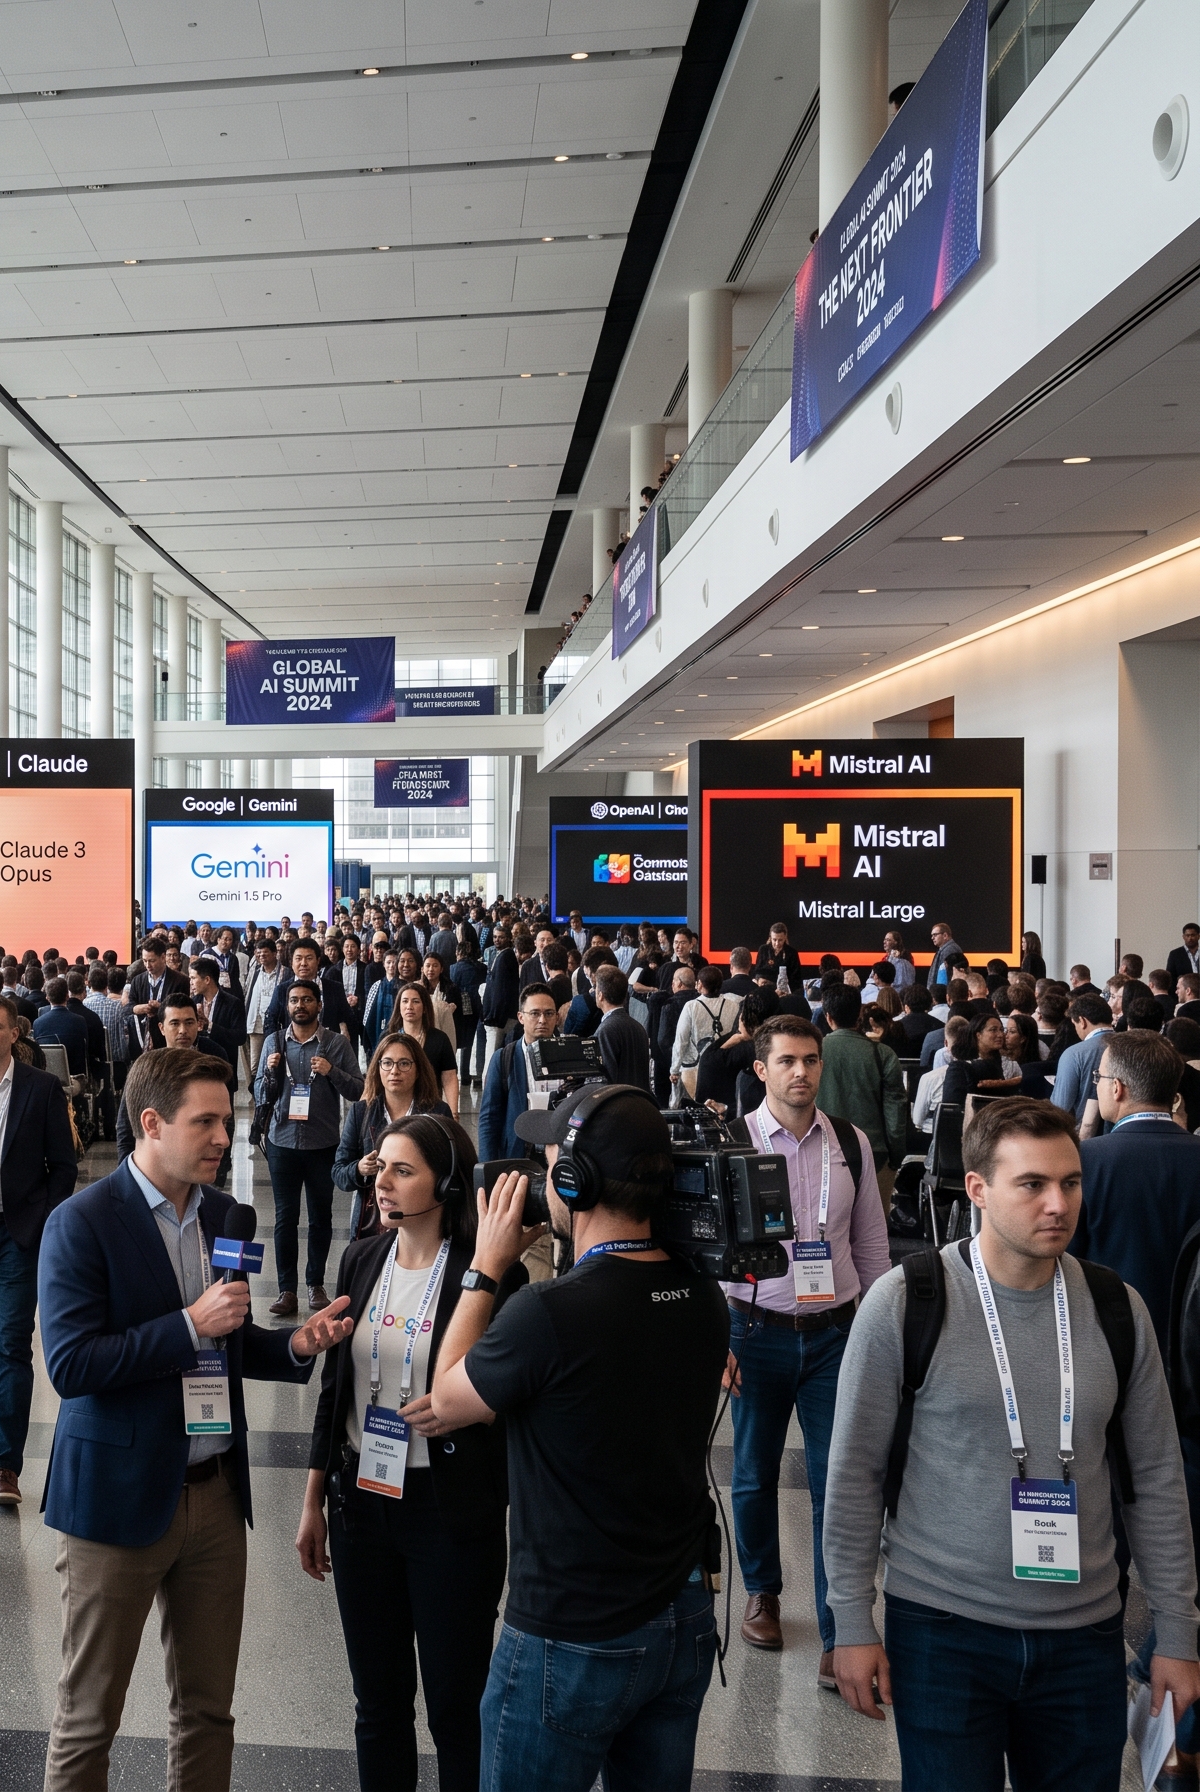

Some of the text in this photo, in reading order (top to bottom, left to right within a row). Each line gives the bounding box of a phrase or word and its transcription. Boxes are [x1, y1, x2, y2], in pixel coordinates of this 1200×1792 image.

[818, 274, 839, 330] THE
[840, 233, 869, 305] NEXT
[871, 147, 933, 264] FRONTIER
[856, 257, 886, 328] 2024
[272, 659, 347, 676] GLOBAL
[259, 676, 360, 694] AI SUMMIT
[286, 694, 333, 712] 2024
[18, 754, 88, 773] Claude
[829, 754, 903, 774] Mistral
[907, 754, 931, 774] AI
[407, 789, 433, 800] 2024
[182, 796, 298, 815] Google Gemini
[609, 804, 655, 818] OpenAI
[854, 824, 945, 848] Mistral
[0, 840, 86, 859] Claude 3
[0, 864, 52, 886] Opus
[190, 853, 290, 879] Gemini
[853, 855, 882, 878] AI
[198, 890, 282, 902] Gemini 1.5 Pro
[799, 900, 926, 923] Mistral Large
[651, 1288, 690, 1302] SONY
